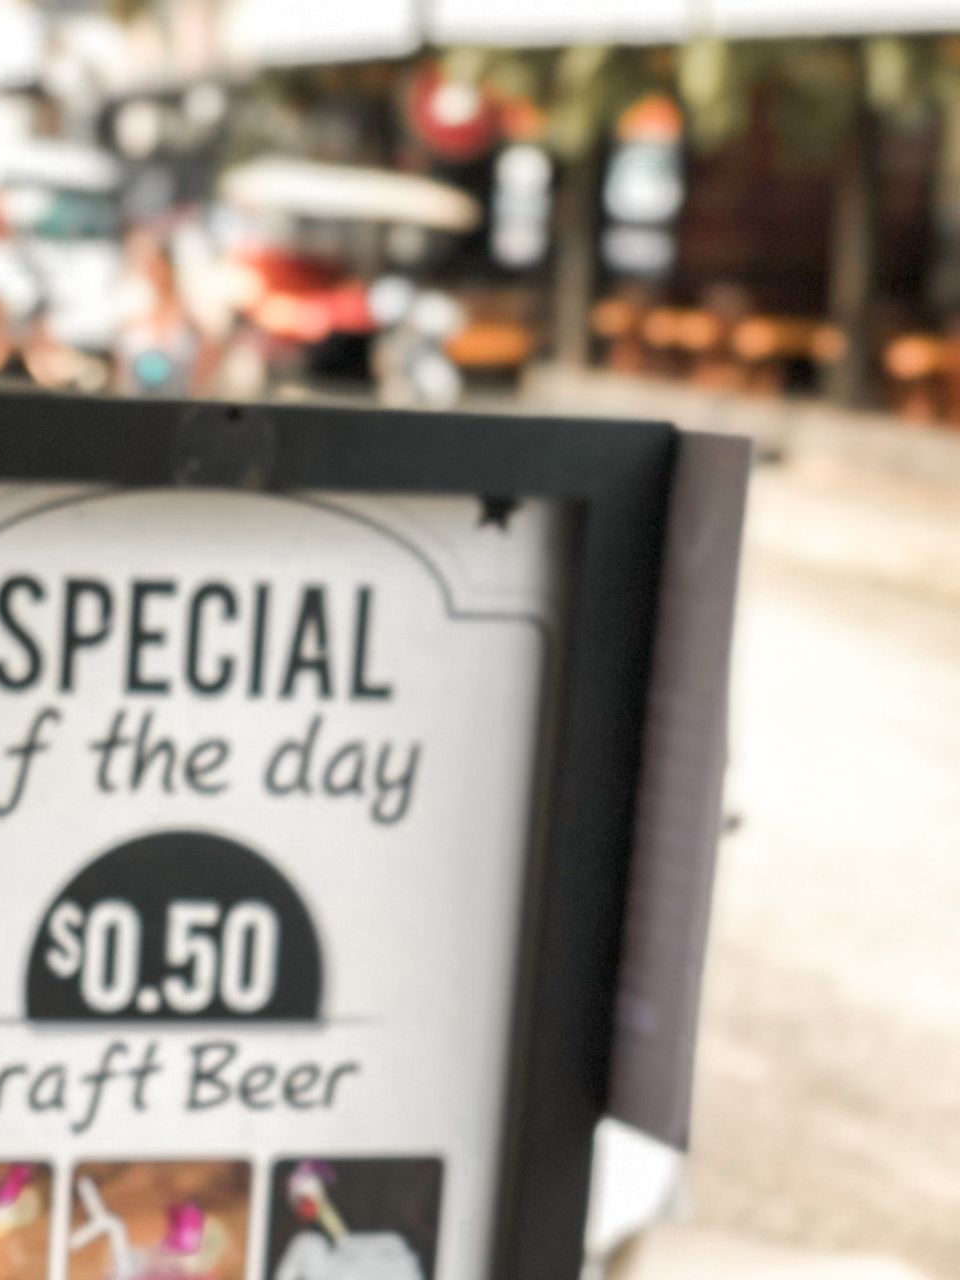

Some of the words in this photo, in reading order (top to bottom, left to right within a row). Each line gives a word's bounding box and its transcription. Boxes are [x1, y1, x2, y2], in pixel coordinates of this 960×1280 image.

[89, 708, 232, 797] the
[263, 713, 421, 826] day
[45, 900, 280, 1014] $0.50
[184, 1040, 361, 1112] Beer
